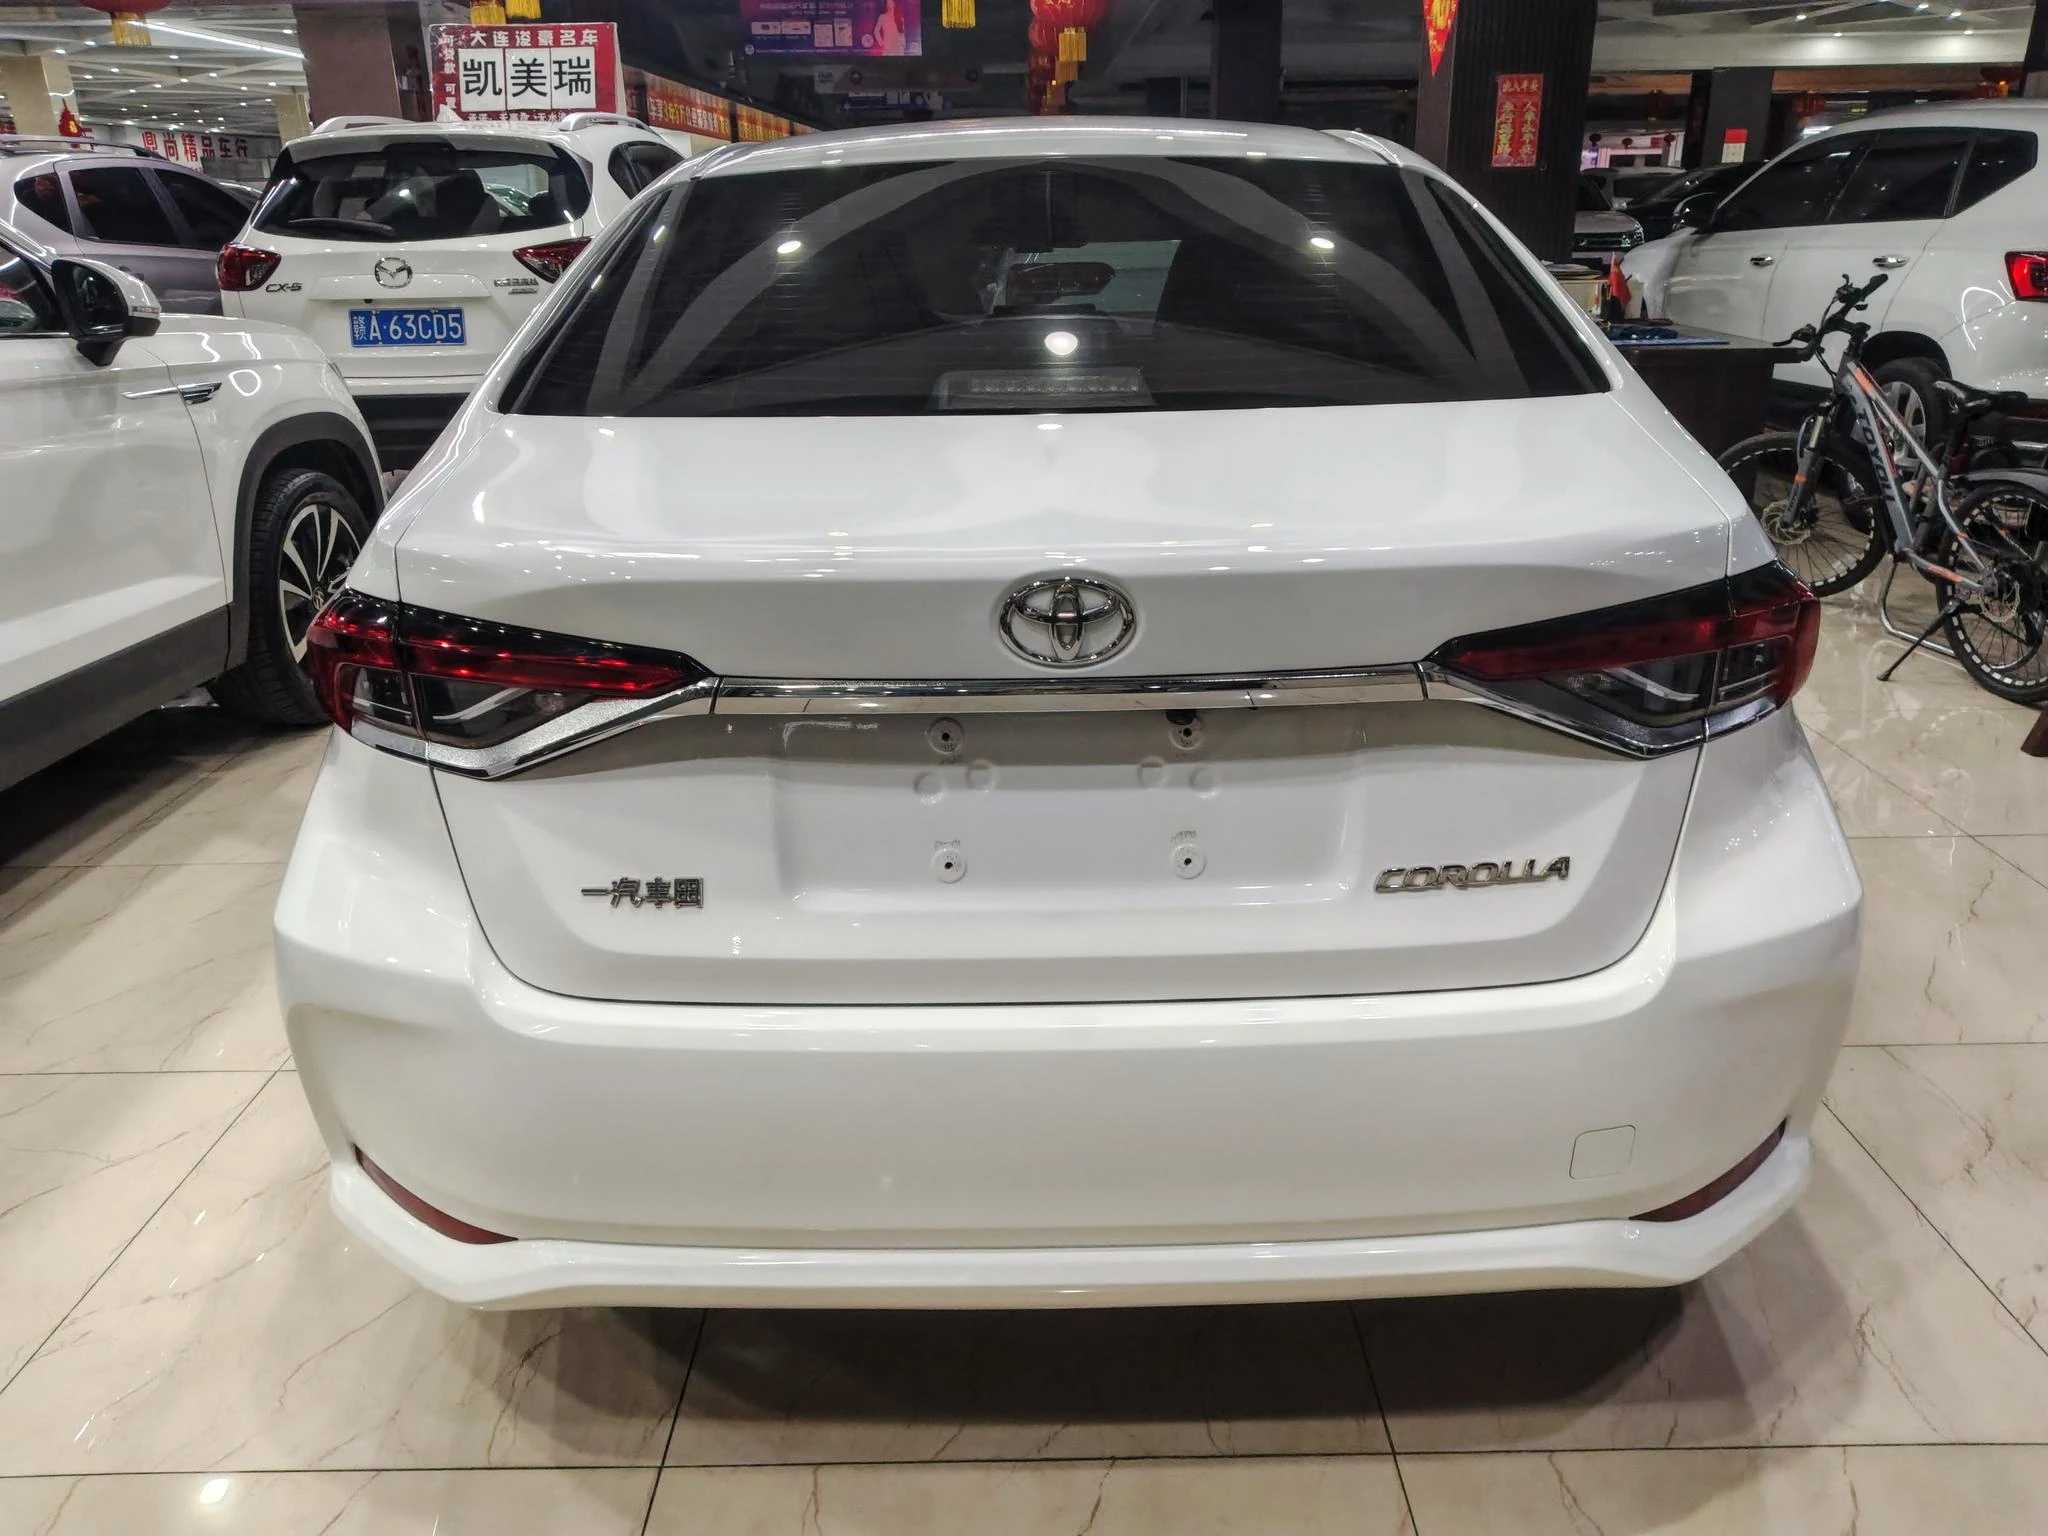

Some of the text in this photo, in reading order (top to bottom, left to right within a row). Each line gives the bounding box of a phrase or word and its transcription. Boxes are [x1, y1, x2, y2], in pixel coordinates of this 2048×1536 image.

[462, 56, 592, 97] 凯美瑞
[265, 282, 302, 293] CX-5
[1373, 856, 1571, 894] COROLLA
